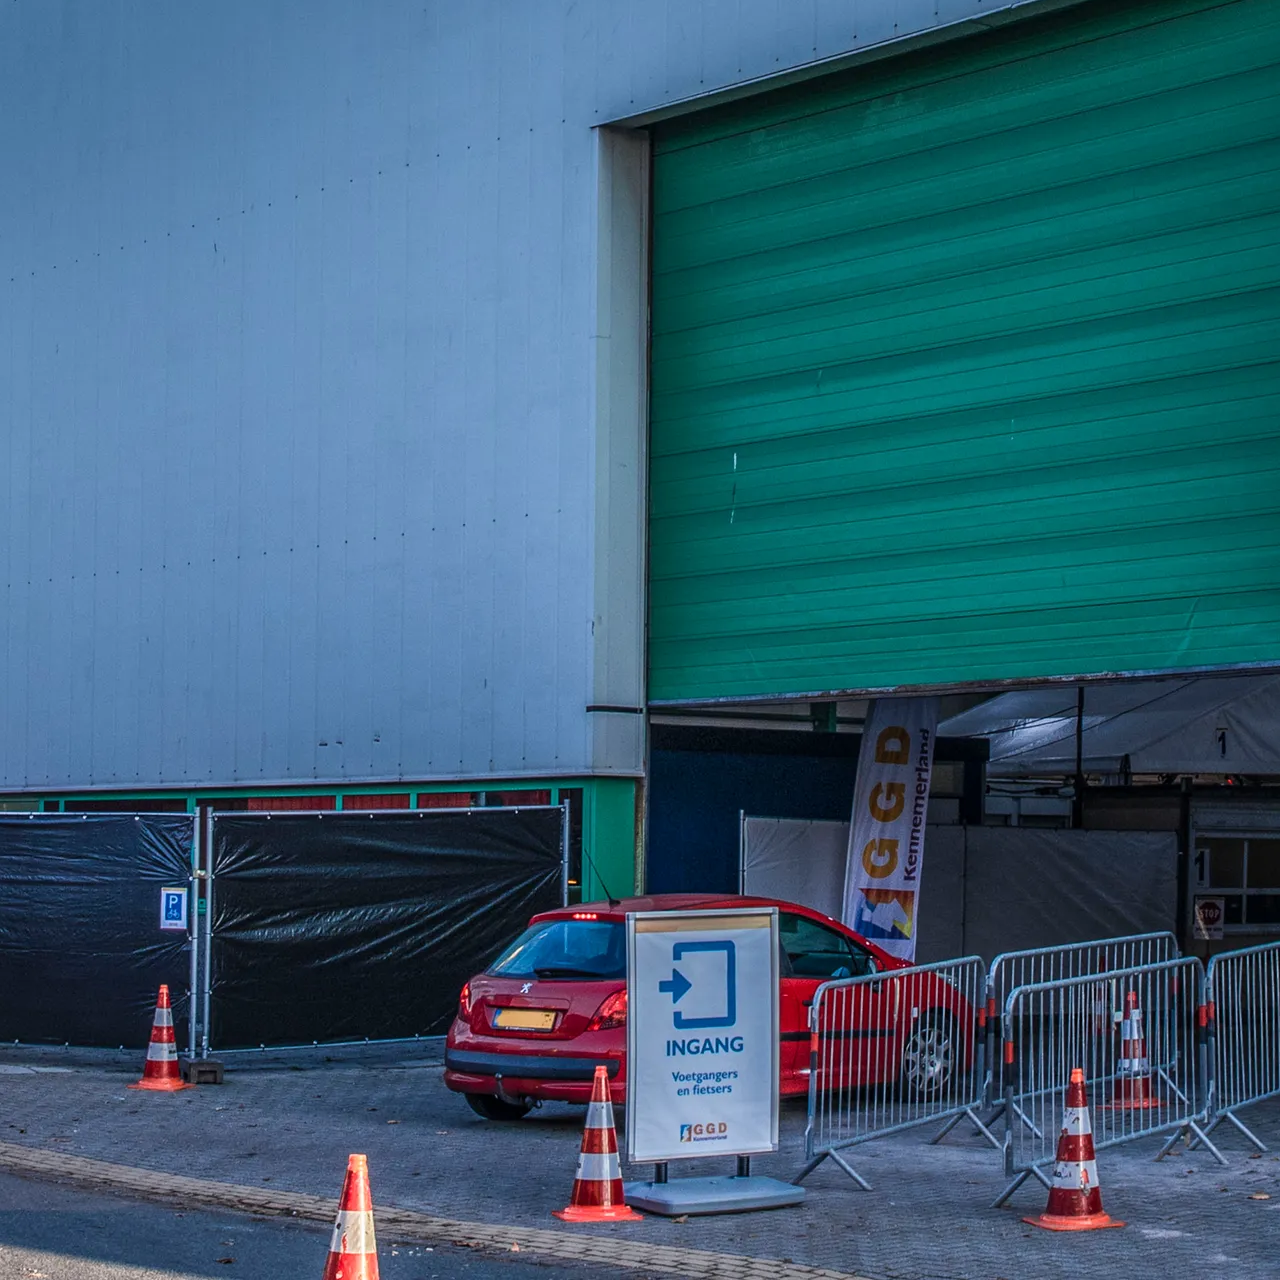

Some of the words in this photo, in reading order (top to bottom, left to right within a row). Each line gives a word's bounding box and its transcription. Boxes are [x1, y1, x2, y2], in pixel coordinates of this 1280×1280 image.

[904, 728, 930, 881] Kennemerland
[169, 895, 179, 909] P
[1199, 908, 1220, 918] STOP
[666, 1036, 744, 1057] INGANG
[672, 1070, 738, 1084] Voetgangers
[677, 1087, 690, 1096] en
[693, 1084, 732, 1095] fietsers
[693, 1134, 728, 1142] Kennemerland
